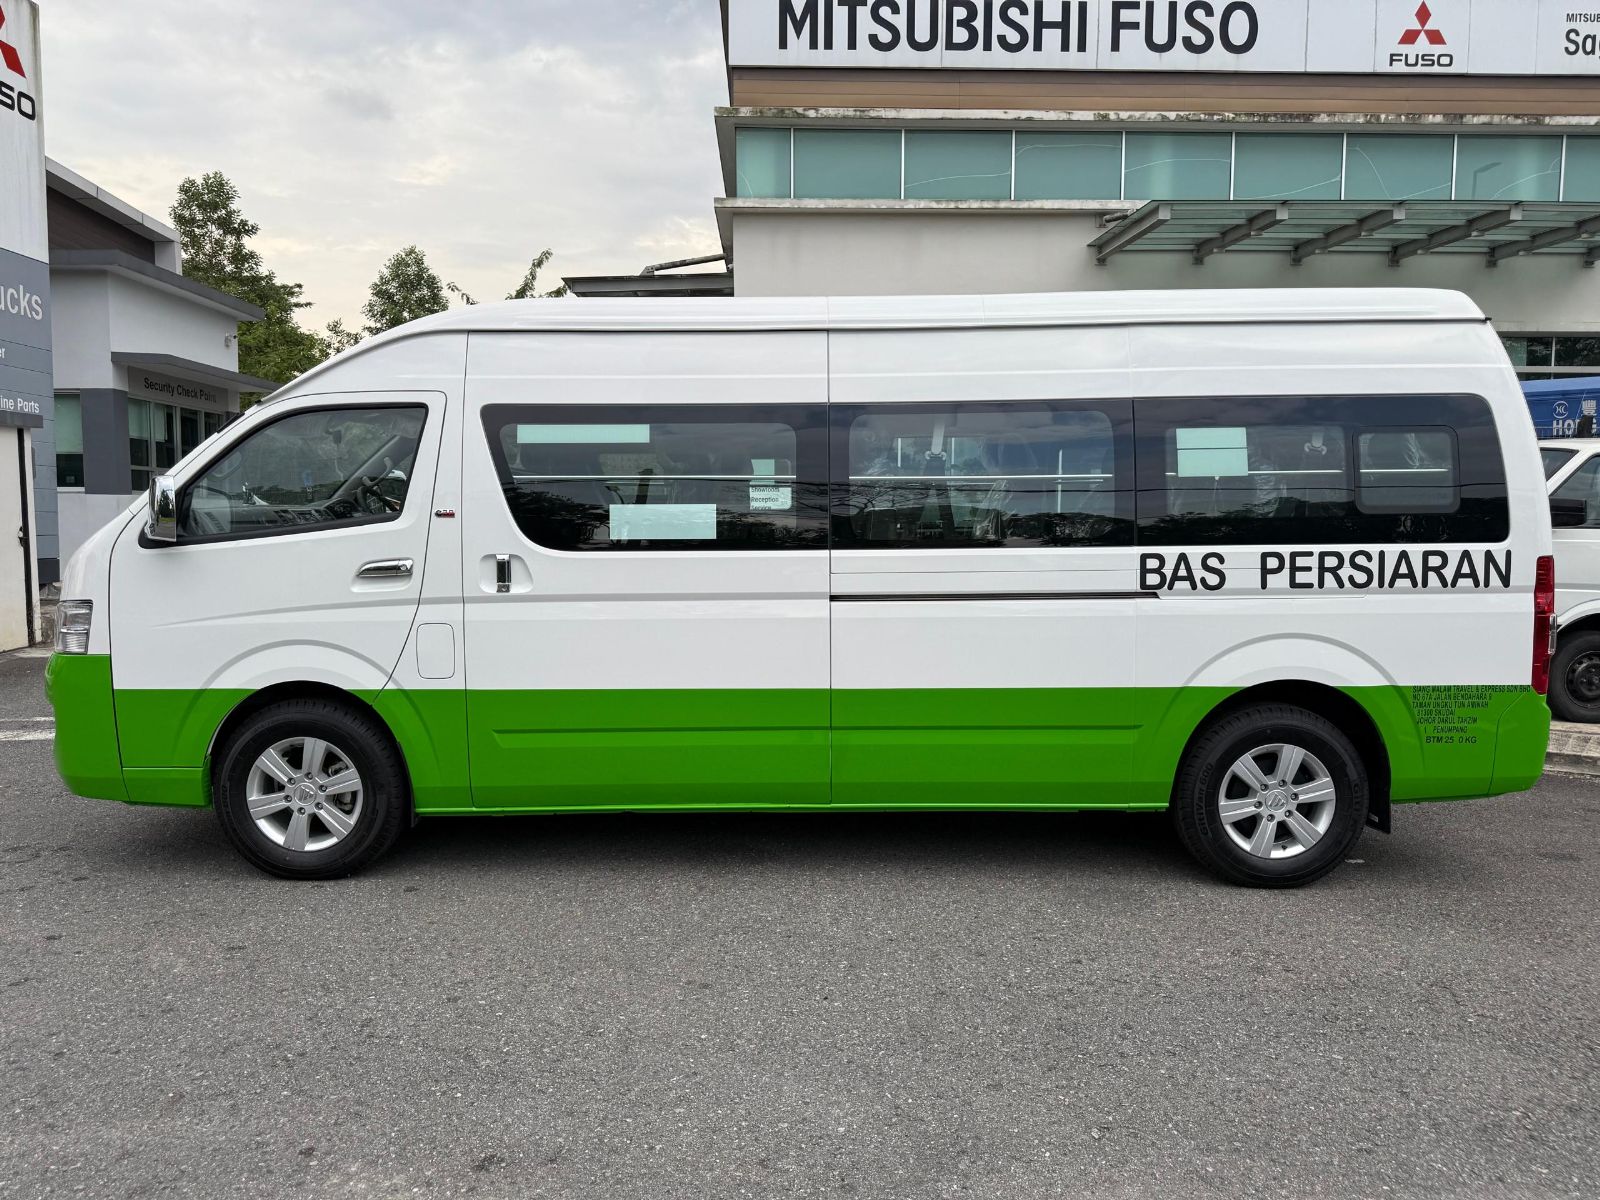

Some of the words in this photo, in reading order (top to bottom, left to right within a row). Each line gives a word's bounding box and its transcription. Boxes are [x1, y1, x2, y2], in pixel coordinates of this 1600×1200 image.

[778, 0, 1087, 53] MITSUBISHI
[1110, 0, 1259, 55] FUSO
[1564, 28, 1600, 60] Sa
[1389, 53, 1454, 67] FUSO
[143, 377, 175, 397] Security
[176, 384, 199, 400] Check
[17, 398, 40, 413] Parts
[1139, 552, 1227, 591] BAS
[1259, 549, 1512, 590] PERSIARAN
[1452, 685, 1475, 693] TRAVEL
[1480, 685, 1506, 693] EXPRESS
[1433, 693, 1452, 701] JALAN
[1453, 693, 1488, 701] BENDAHARA
[1412, 701, 1432, 709] TAMAN
[1432, 701, 1453, 709] UNGKU
[1454, 701, 1466, 709] TUN
[1416, 716, 1436, 725] JOHOR
[1437, 716, 1456, 724] DARUL
[1433, 725, 1468, 733] PENUMPANG
[1425, 736, 1445, 744] BTM
[1464, 736, 1477, 744] KG
